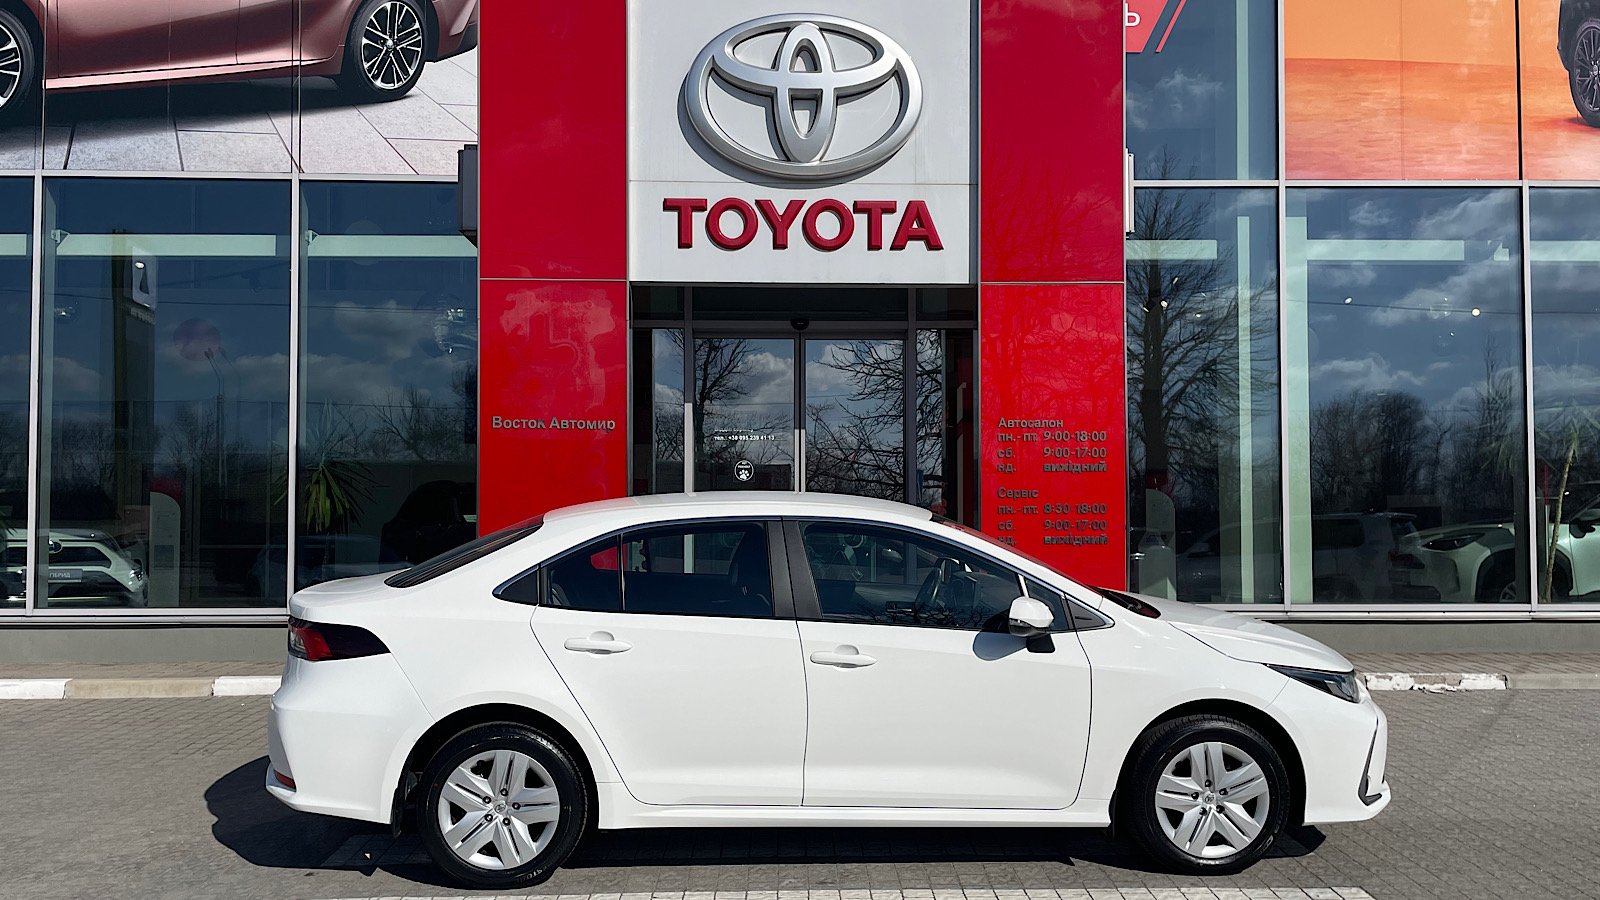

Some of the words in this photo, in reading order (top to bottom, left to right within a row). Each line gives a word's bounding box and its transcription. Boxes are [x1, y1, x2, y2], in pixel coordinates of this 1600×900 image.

[663, 197, 944, 252] TOYOTA
[492, 416, 546, 429] Восток
[549, 417, 616, 433] Автомир
[998, 417, 1064, 428] Автосалон
[1043, 431, 1107, 441] 9:00-18:00
[998, 447, 1016, 458] сб.
[1043, 447, 1107, 458] 9:00-17:00
[998, 463, 1016, 474] нд.
[1043, 460, 1107, 474] вихідний
[998, 487, 1039, 500] Сервіс
[1043, 503, 1107, 514] 8:30-18:00
[998, 520, 1016, 531] сб.
[1043, 520, 1107, 531] 9:00-17:00
[1043, 533, 1108, 547] вихідний
